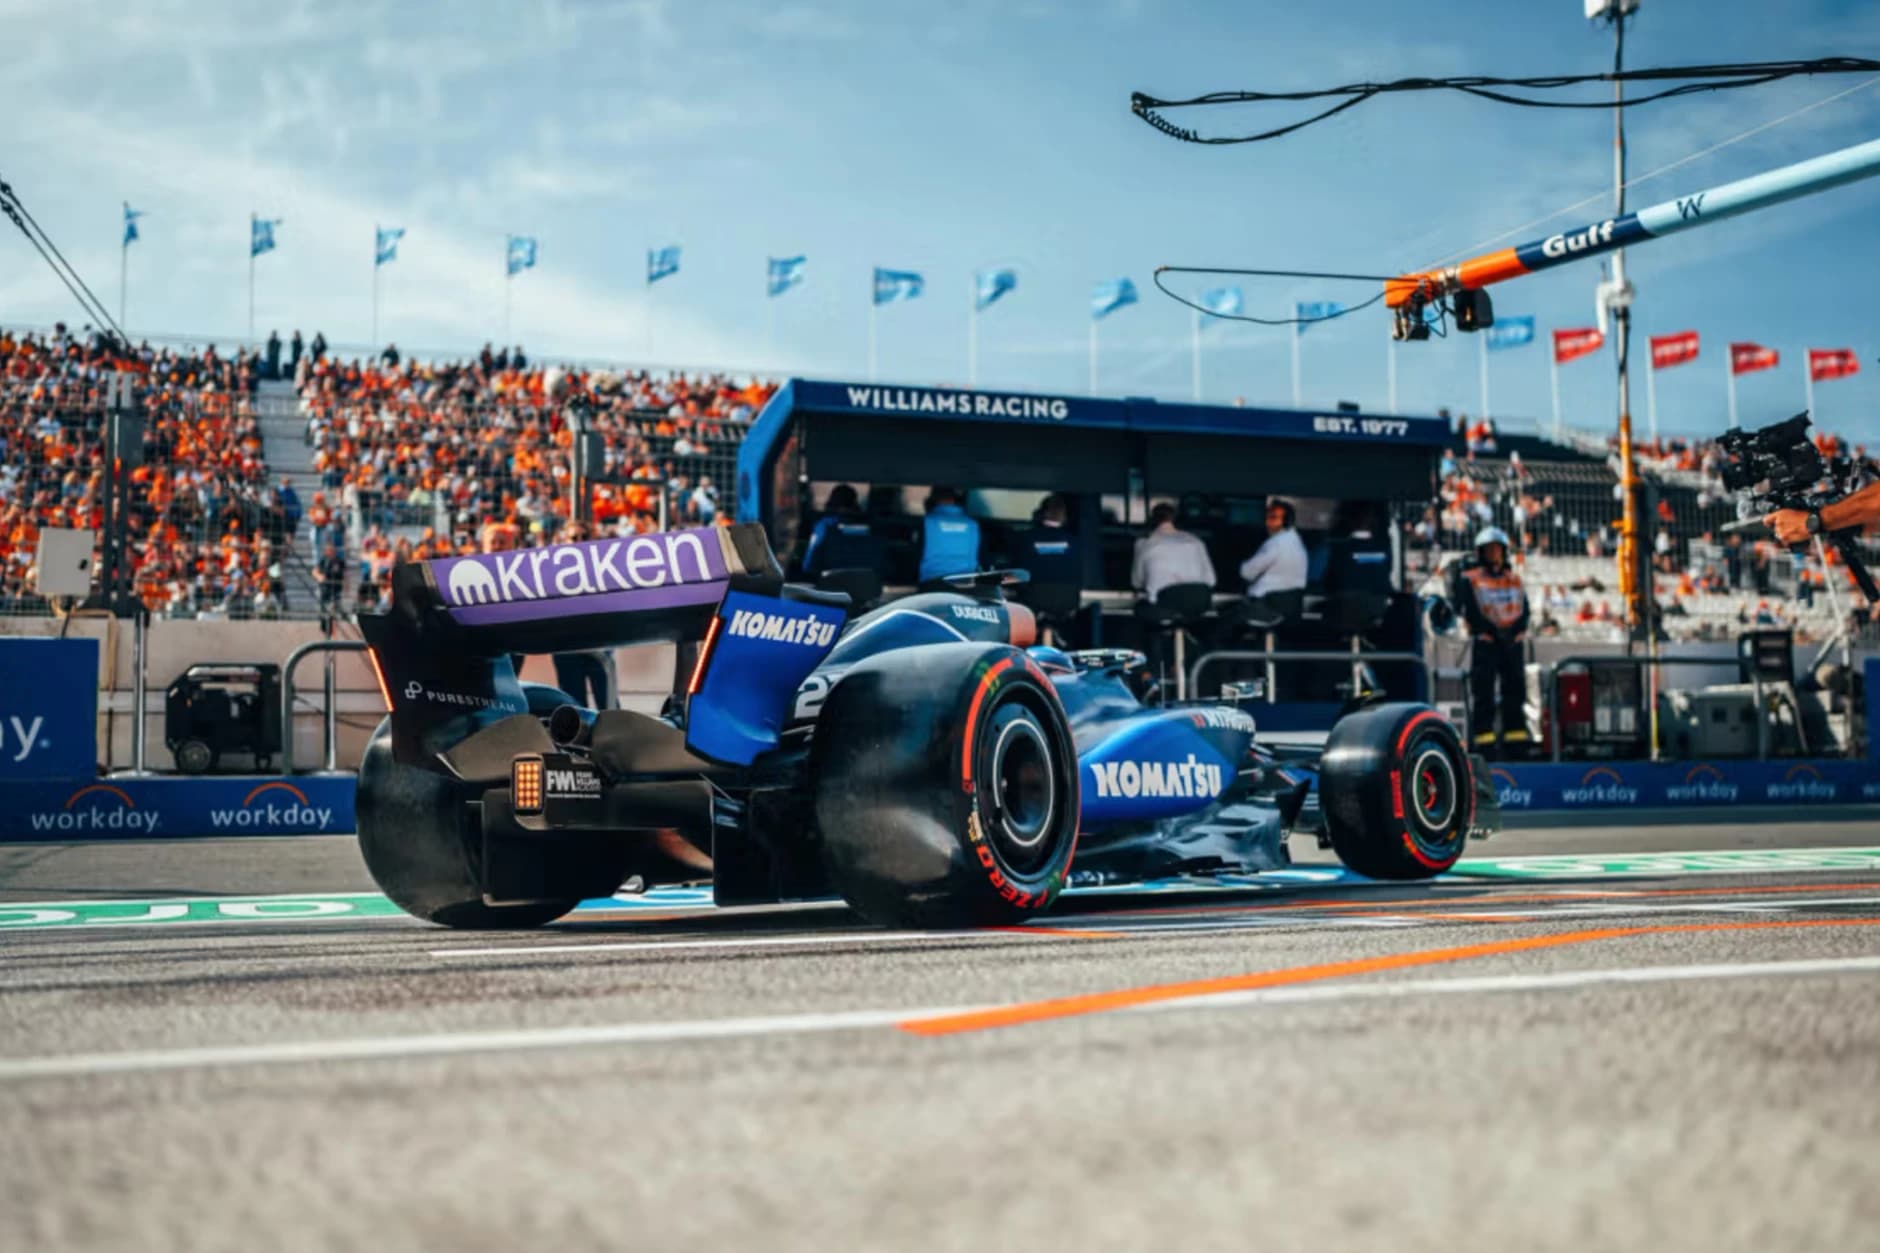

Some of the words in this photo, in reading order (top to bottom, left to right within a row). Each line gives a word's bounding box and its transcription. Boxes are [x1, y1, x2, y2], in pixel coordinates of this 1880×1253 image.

[1542, 219, 1616, 258] Gulf
[847, 387, 971, 414] WILLIAMS
[975, 395, 1068, 419] RACING
[1313, 416, 1357, 434] EST.
[1361, 419, 1409, 436] 1977
[495, 532, 713, 601] kraken
[728, 609, 836, 647] KOMATSU
[426, 690, 517, 713] PURESTREAM
[1089, 753, 1222, 798] KOMATSU
[976, 844, 1031, 908] ZERO
